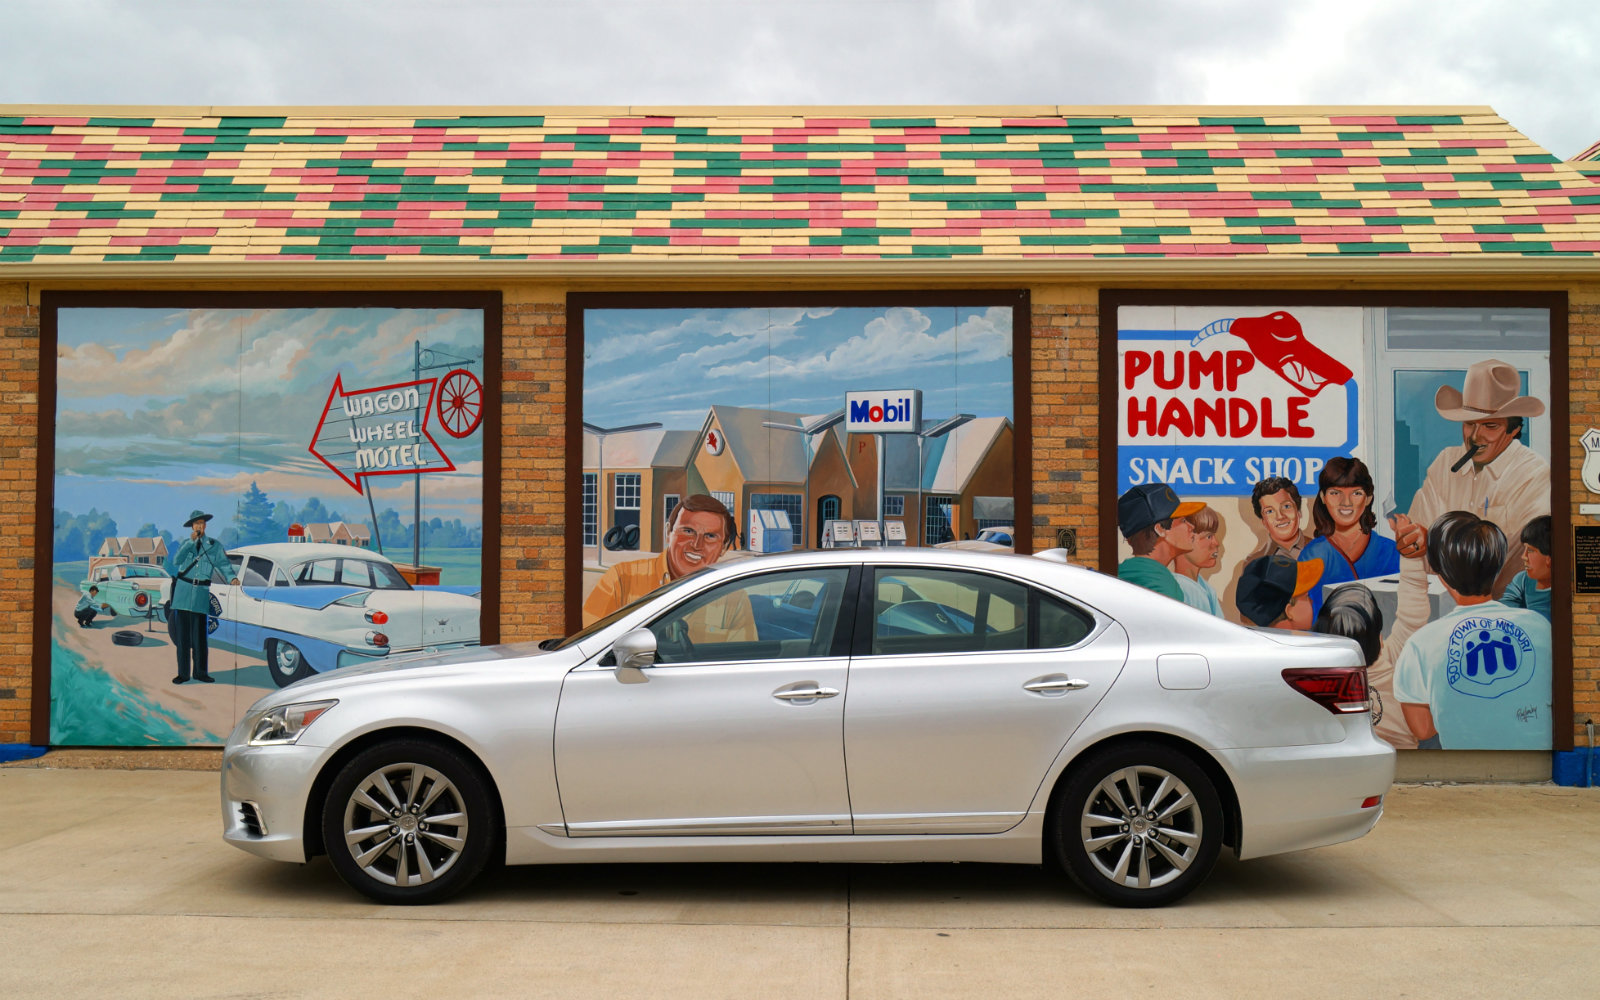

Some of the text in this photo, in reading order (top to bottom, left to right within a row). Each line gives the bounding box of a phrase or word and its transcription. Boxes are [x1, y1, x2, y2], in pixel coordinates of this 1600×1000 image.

[1124, 350, 1255, 392] PUMP
[343, 388, 420, 417] WAGON
[850, 398, 911, 423] Mobil
[1127, 396, 1315, 438] HANDLE
[349, 420, 420, 443] WHEEL
[355, 443, 428, 469] MOTEL
[858, 441, 867, 454] P
[1128, 457, 1324, 485] SNACK SHOP
[1448, 619, 1533, 685] BOYS TOWN OF MISSOURI
